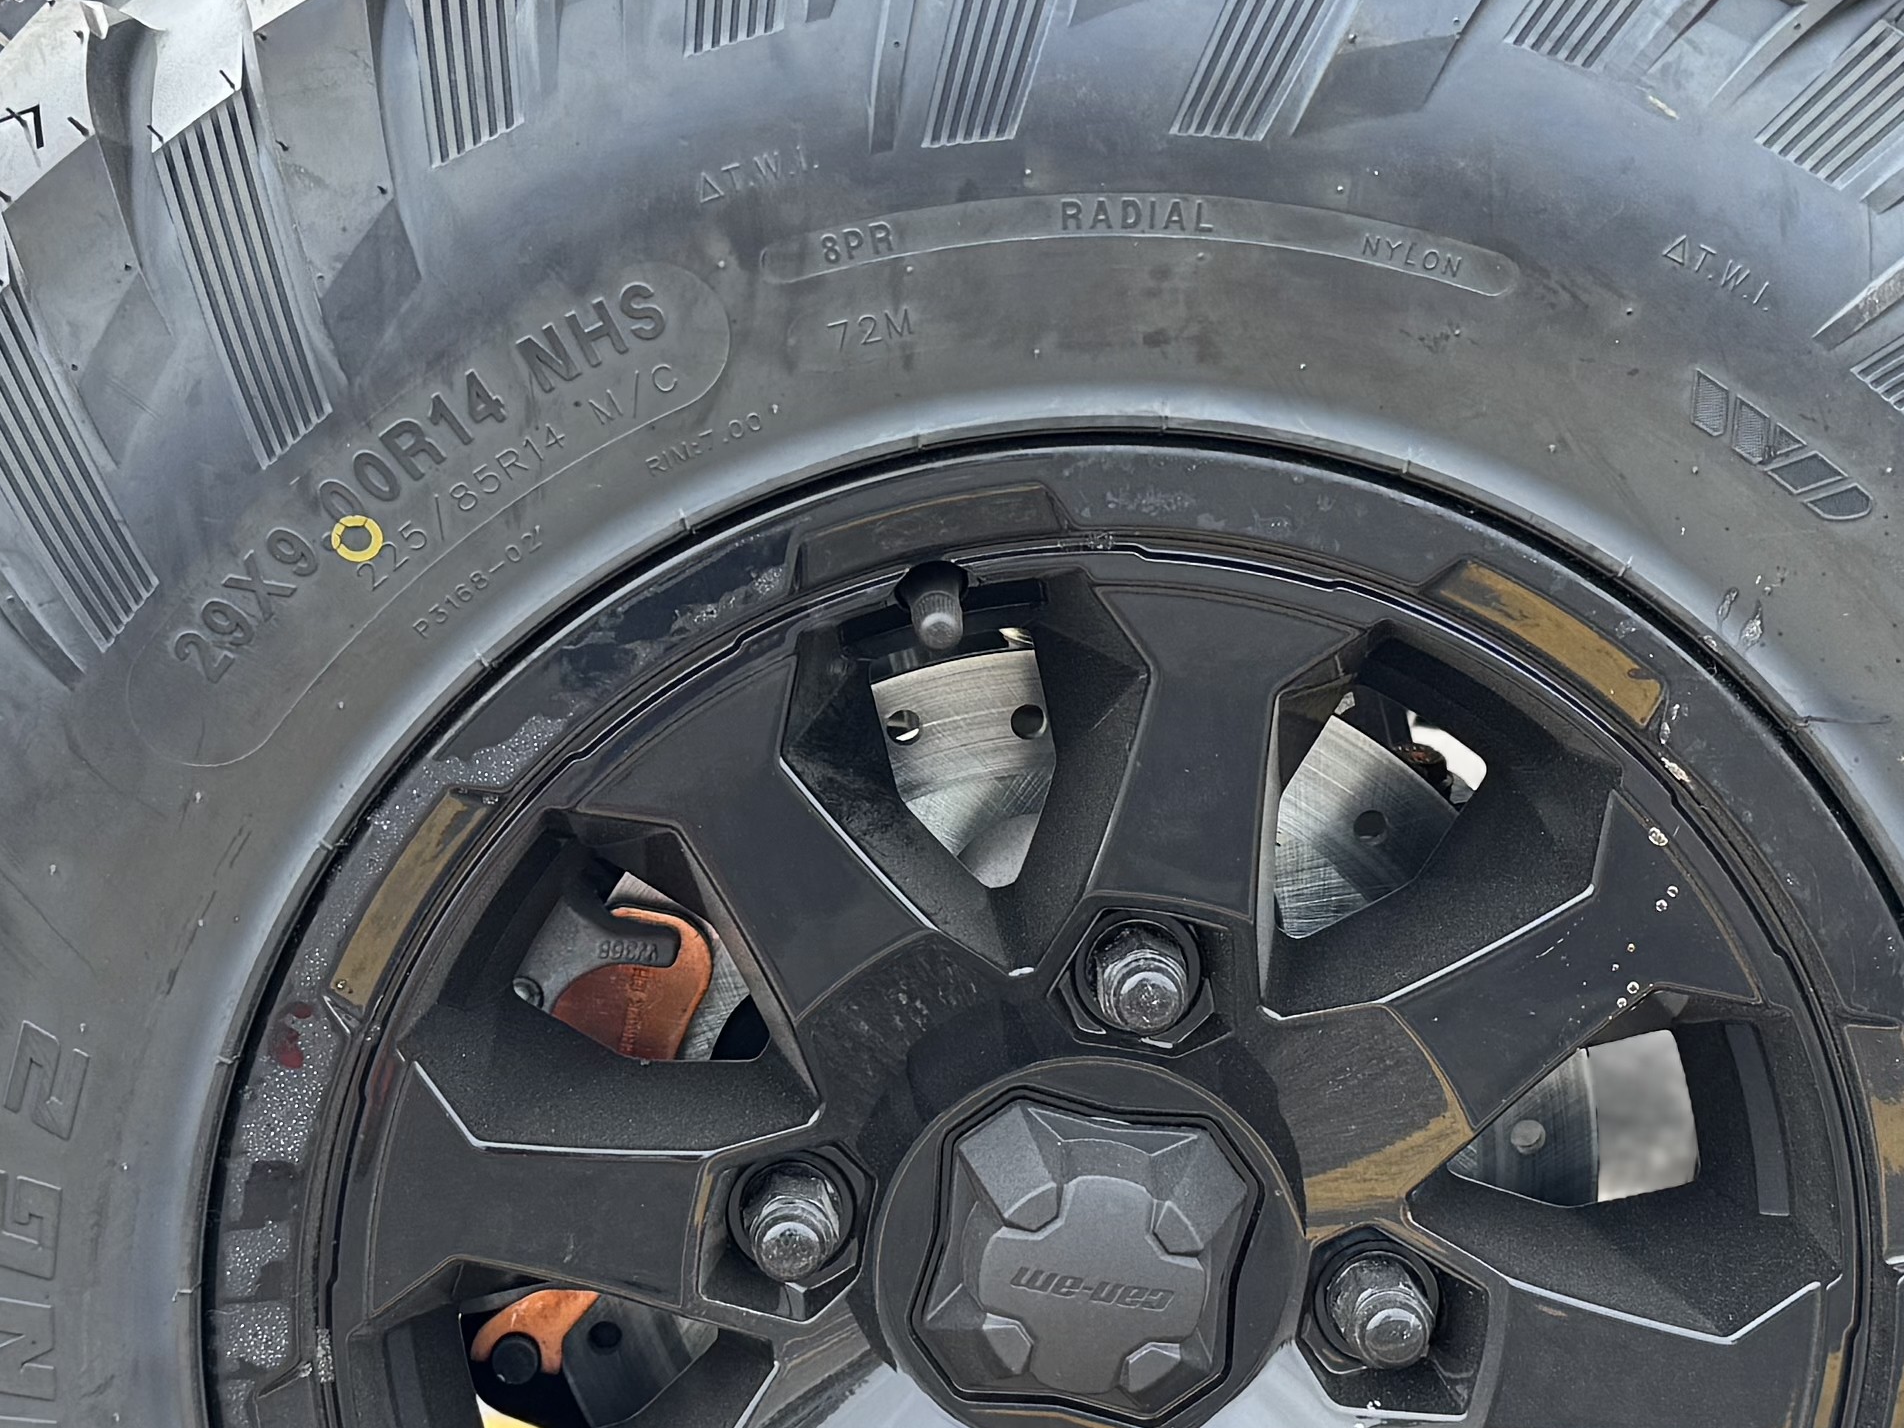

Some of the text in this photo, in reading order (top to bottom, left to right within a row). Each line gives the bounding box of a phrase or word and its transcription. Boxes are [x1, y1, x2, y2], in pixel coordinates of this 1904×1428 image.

[1060, 195, 1214, 233] RADIAL
[820, 220, 894, 265] 8PR
[1361, 233, 1463, 278] NYLON
[516, 281, 667, 394] NHS
[826, 305, 914, 353] 72M
[356, 363, 680, 591] 225/85R14 M/C
[3, 1019, 90, 1141] 2
